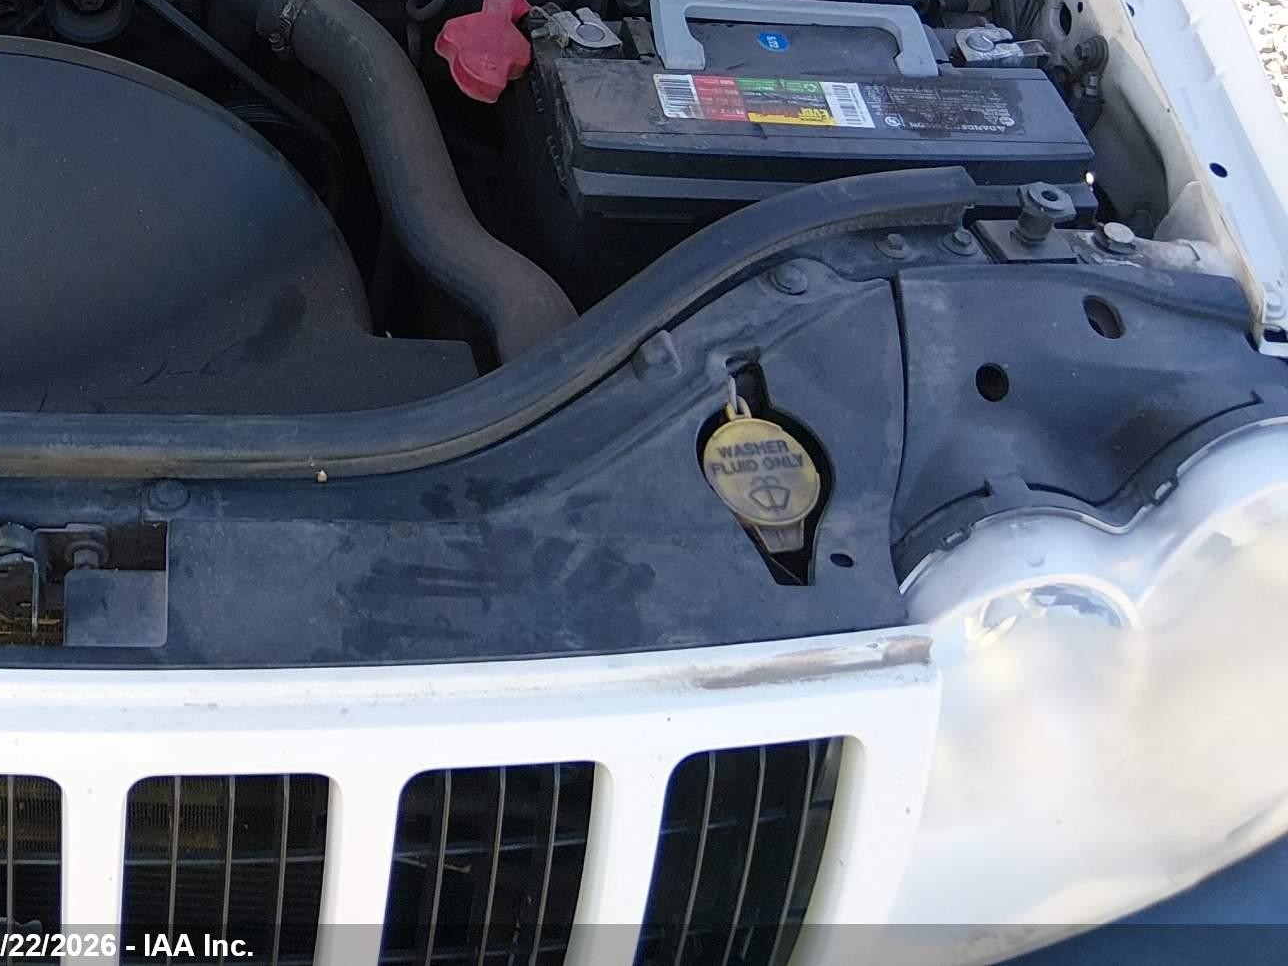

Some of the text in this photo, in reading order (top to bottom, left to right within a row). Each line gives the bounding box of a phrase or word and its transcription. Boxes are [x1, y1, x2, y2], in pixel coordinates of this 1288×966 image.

[718, 440, 789, 458] WASHER
[710, 453, 804, 475] FLUID ONLY
